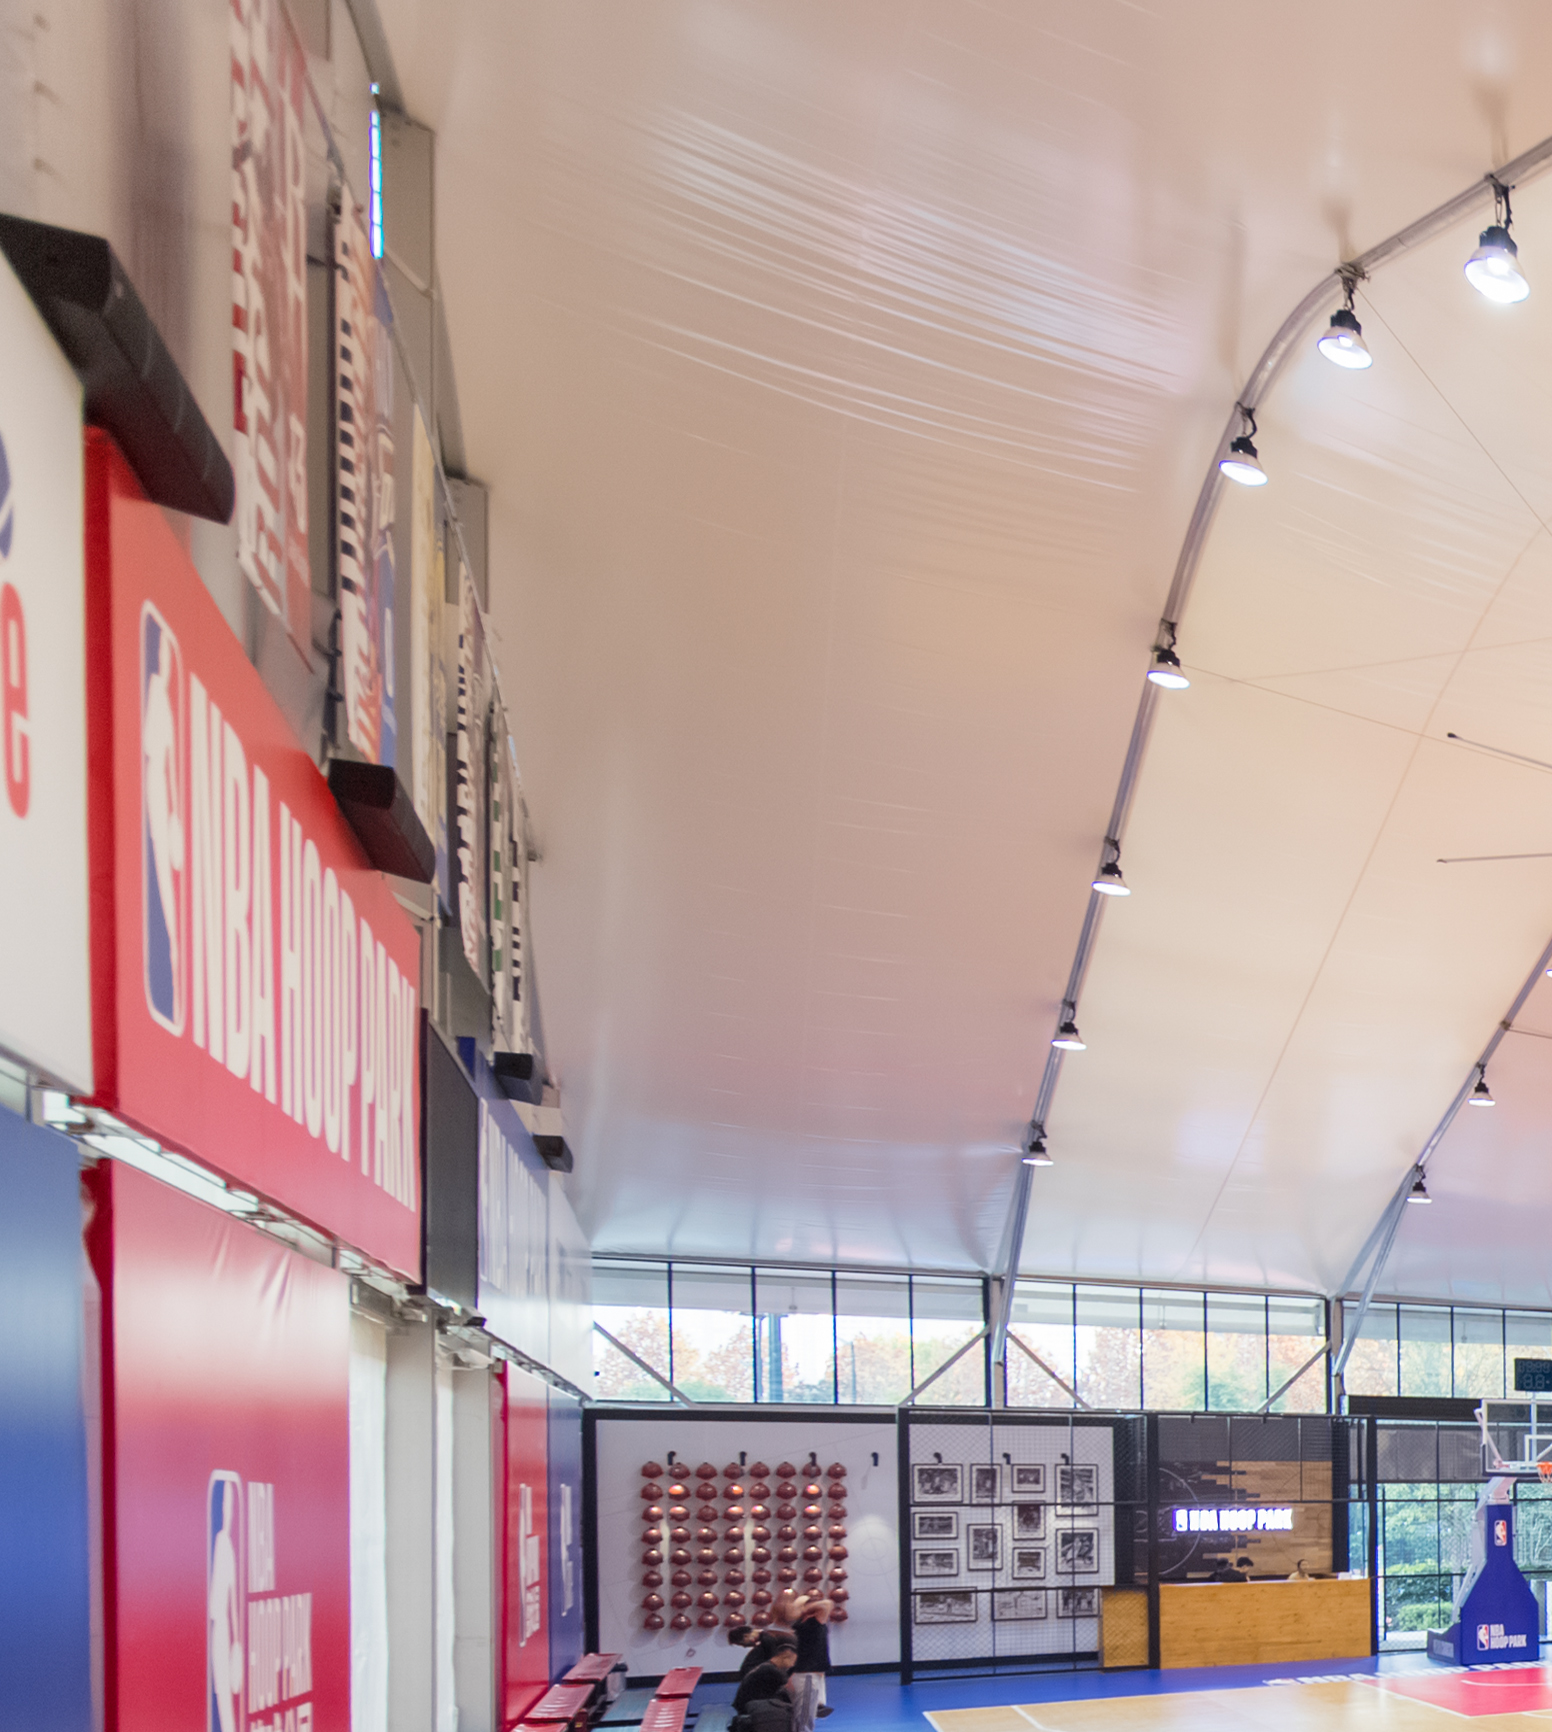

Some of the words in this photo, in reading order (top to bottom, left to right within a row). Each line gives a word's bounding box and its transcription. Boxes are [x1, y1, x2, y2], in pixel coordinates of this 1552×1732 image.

[189, 671, 276, 1105] NBA
[280, 801, 357, 1163] HOOP
[360, 915, 417, 1213] PARK
[1489, 1624, 1505, 1636] NBA
[1490, 1635, 1508, 1649] HOOP
[1508, 1634, 1527, 1648] PARK
